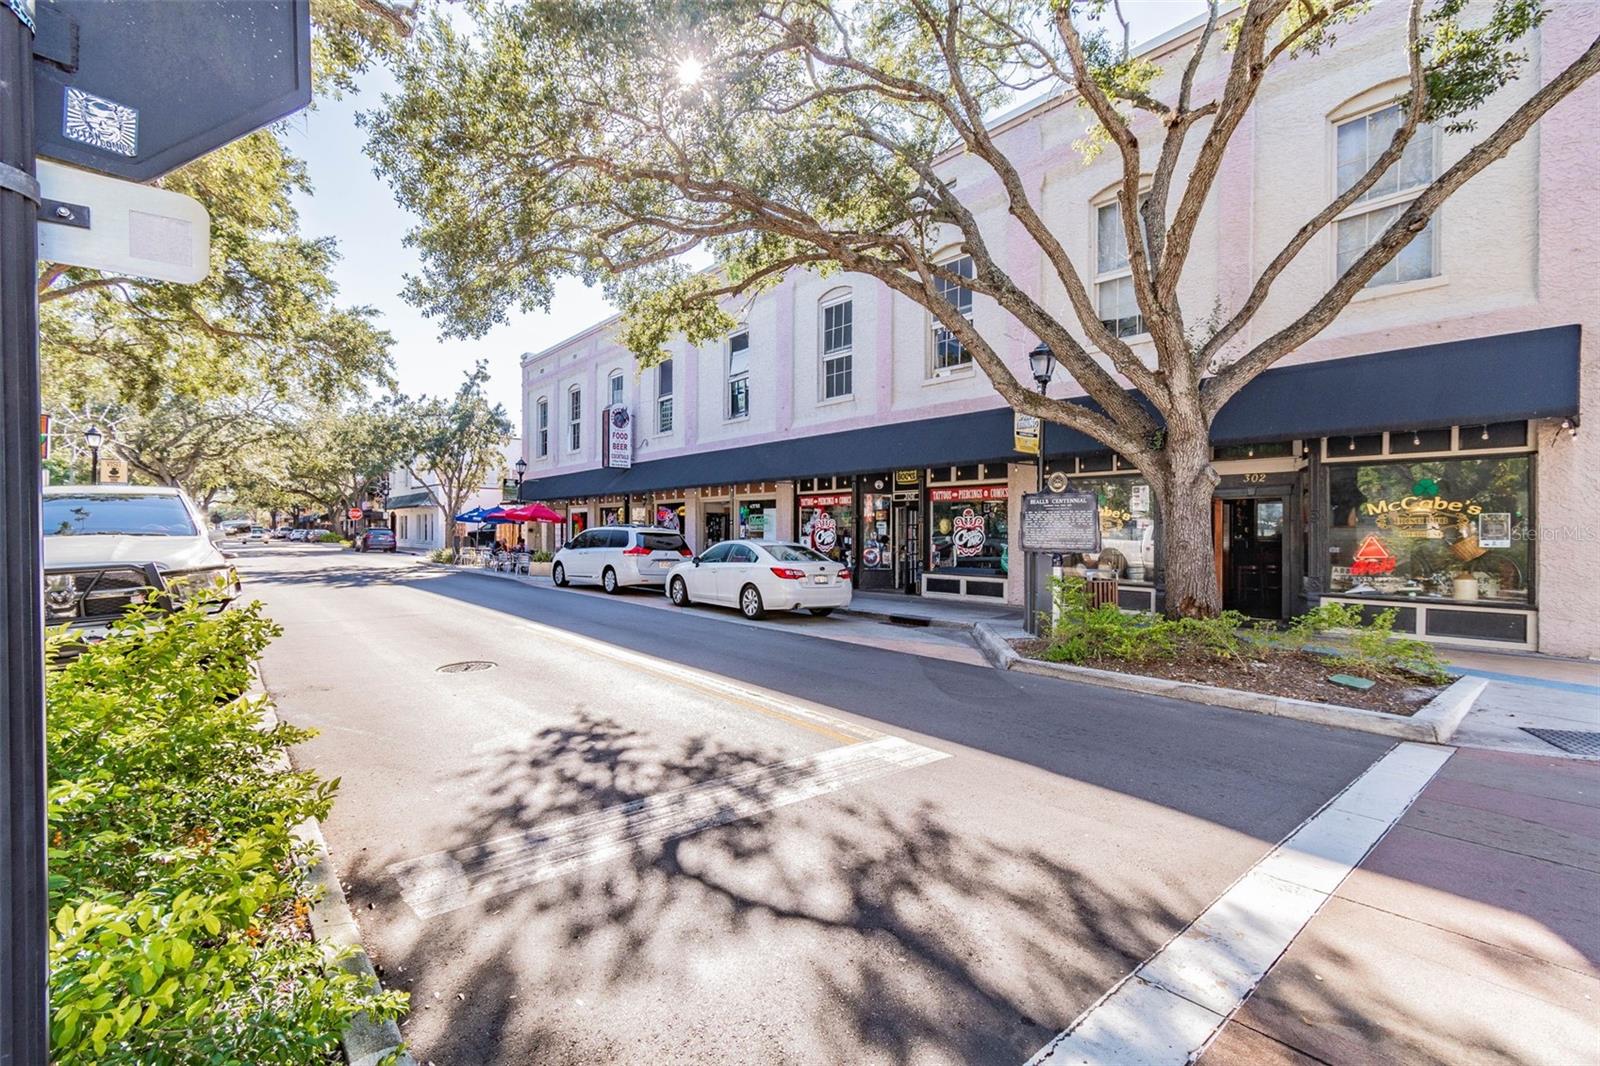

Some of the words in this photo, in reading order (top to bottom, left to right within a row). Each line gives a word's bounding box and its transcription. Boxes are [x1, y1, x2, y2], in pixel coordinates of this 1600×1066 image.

[612, 432, 628, 440] FOOD
[1243, 473, 1266, 483] 302
[933, 490, 952, 500] TATTOOS
[958, 489, 983, 499] PIERCINGS
[990, 488, 1009, 498] COMICS
[1366, 496, 1482, 515] McCabe's
